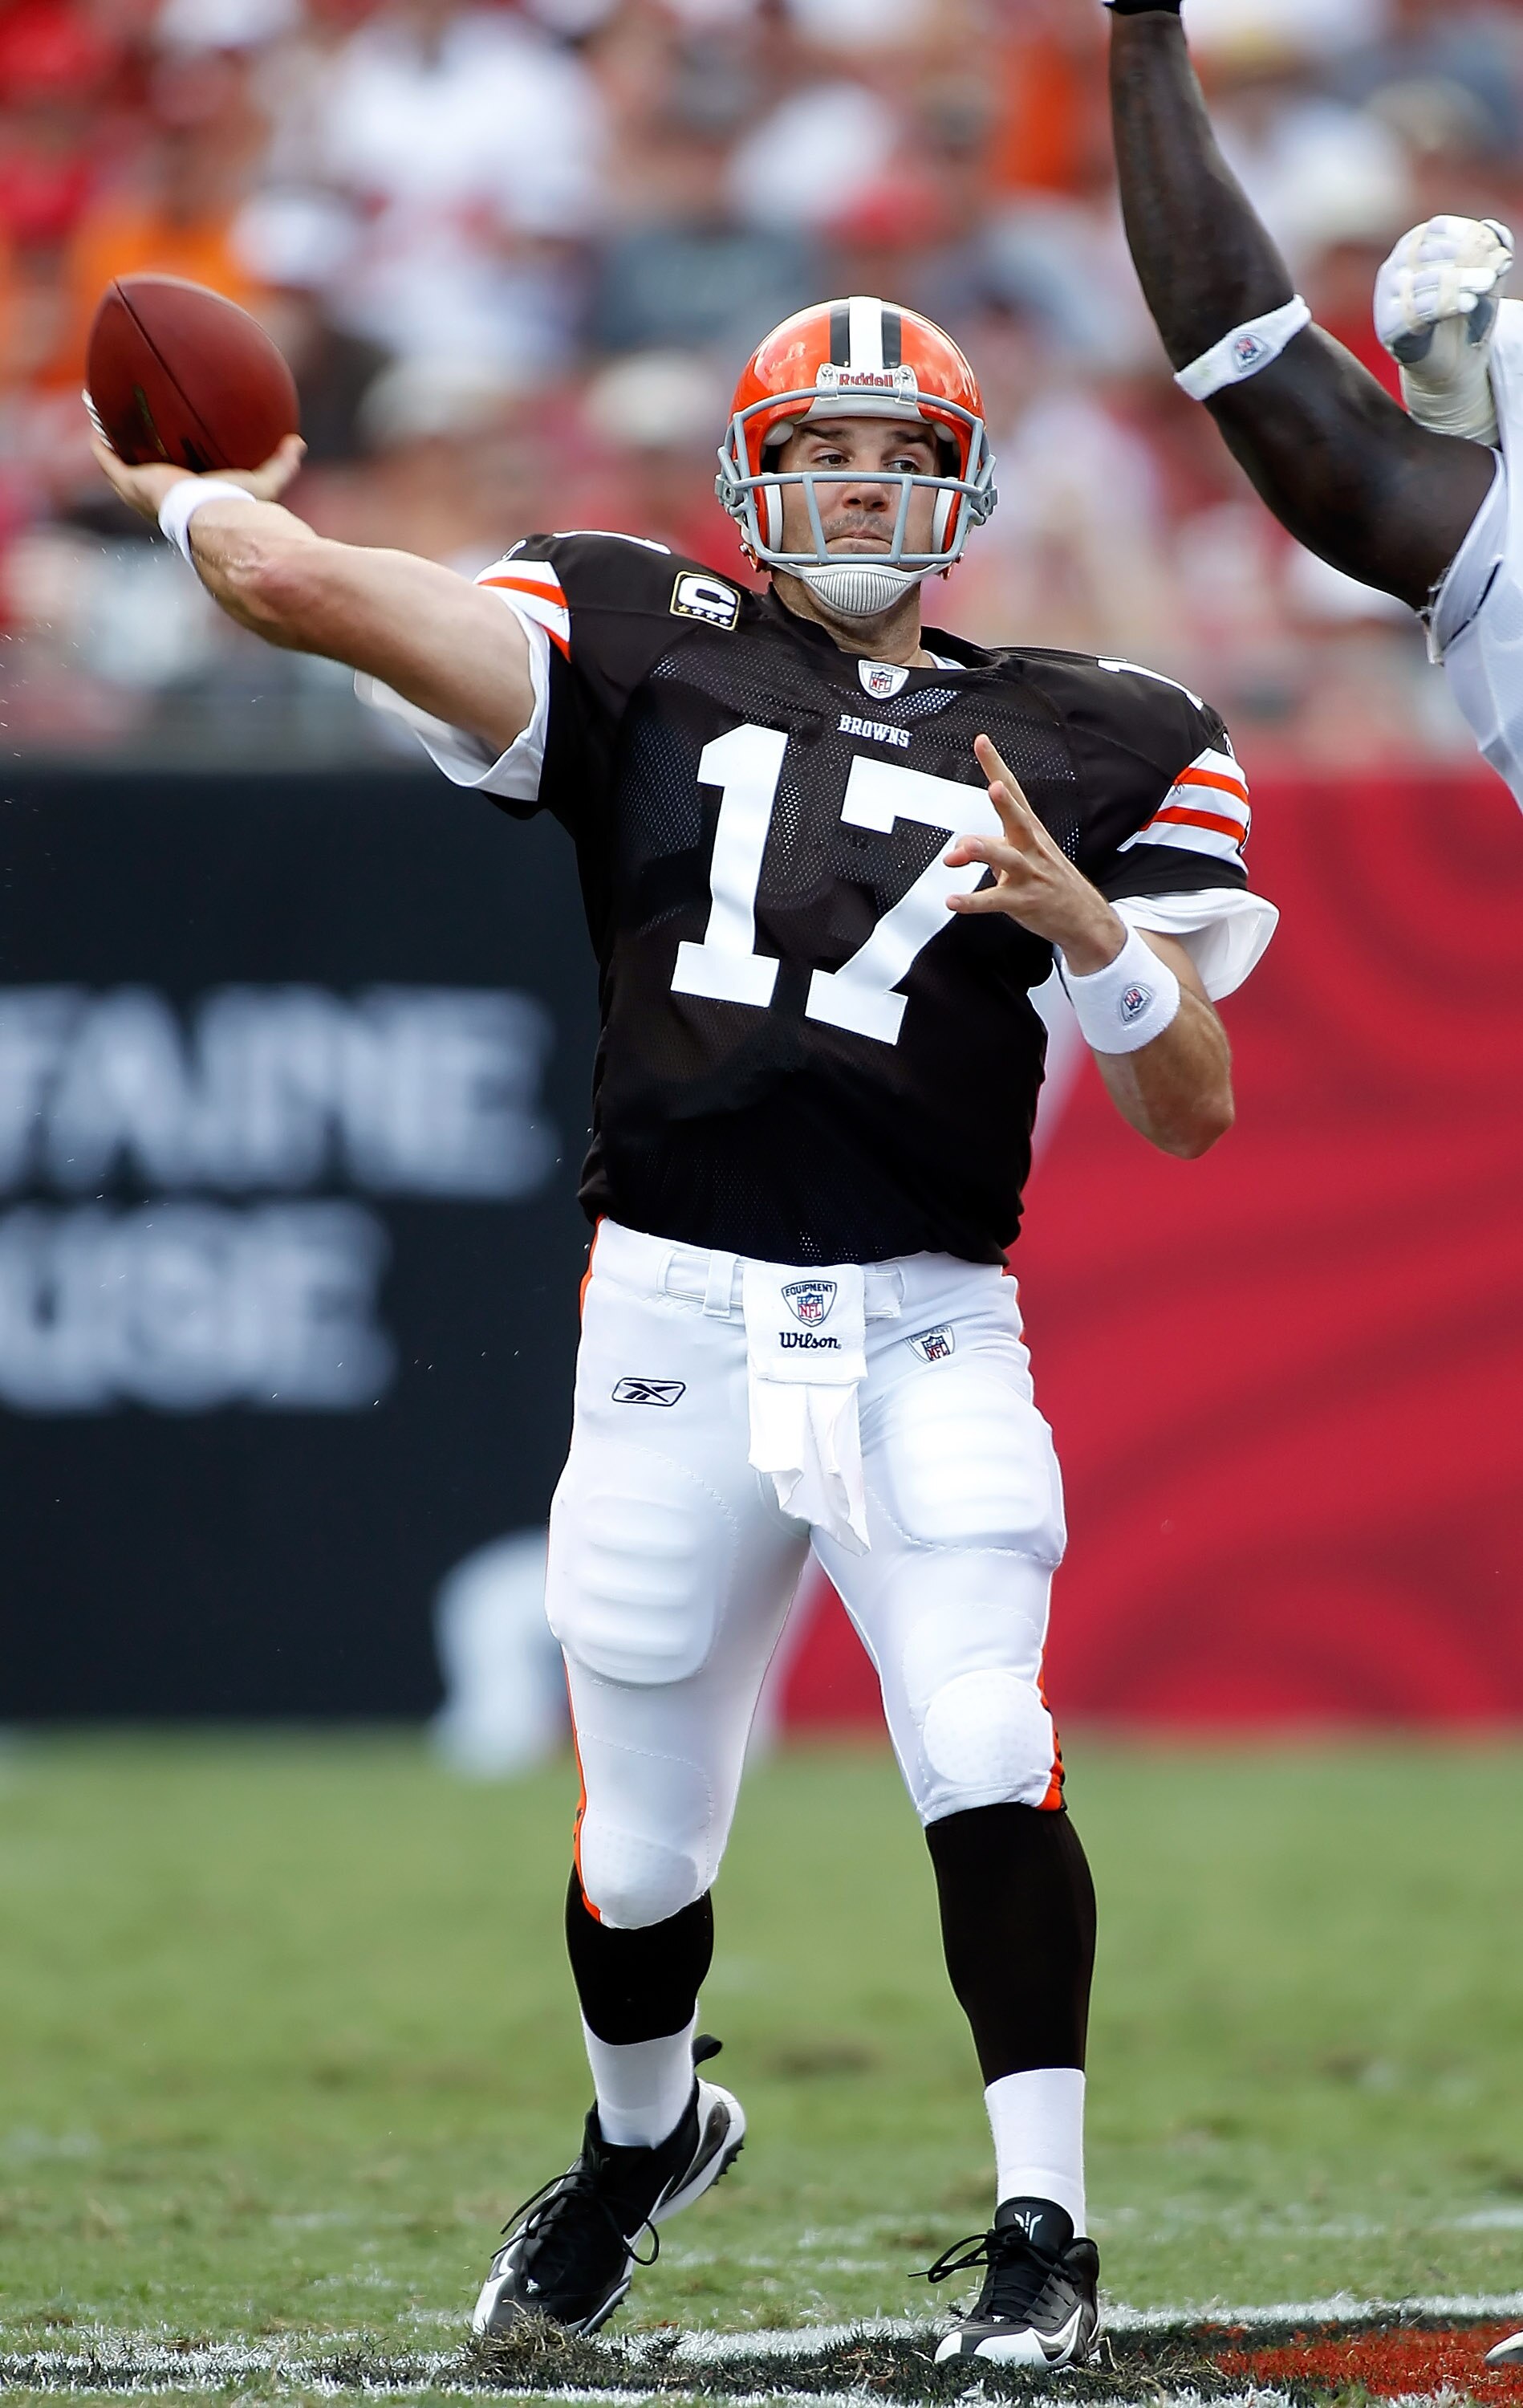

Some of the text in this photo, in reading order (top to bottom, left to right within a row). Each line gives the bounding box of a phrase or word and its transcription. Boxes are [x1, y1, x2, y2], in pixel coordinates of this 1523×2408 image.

[839, 372, 893, 388] Riddell
[871, 679, 890, 690] NFL
[837, 714, 911, 748] BROWNS
[671, 723, 1003, 1045] 17
[786, 1283, 833, 1296] EQUIPMENT
[799, 1304, 821, 1319] NFL
[778, 1332, 838, 1348] Wilson
[927, 1344, 949, 1360] NFL
